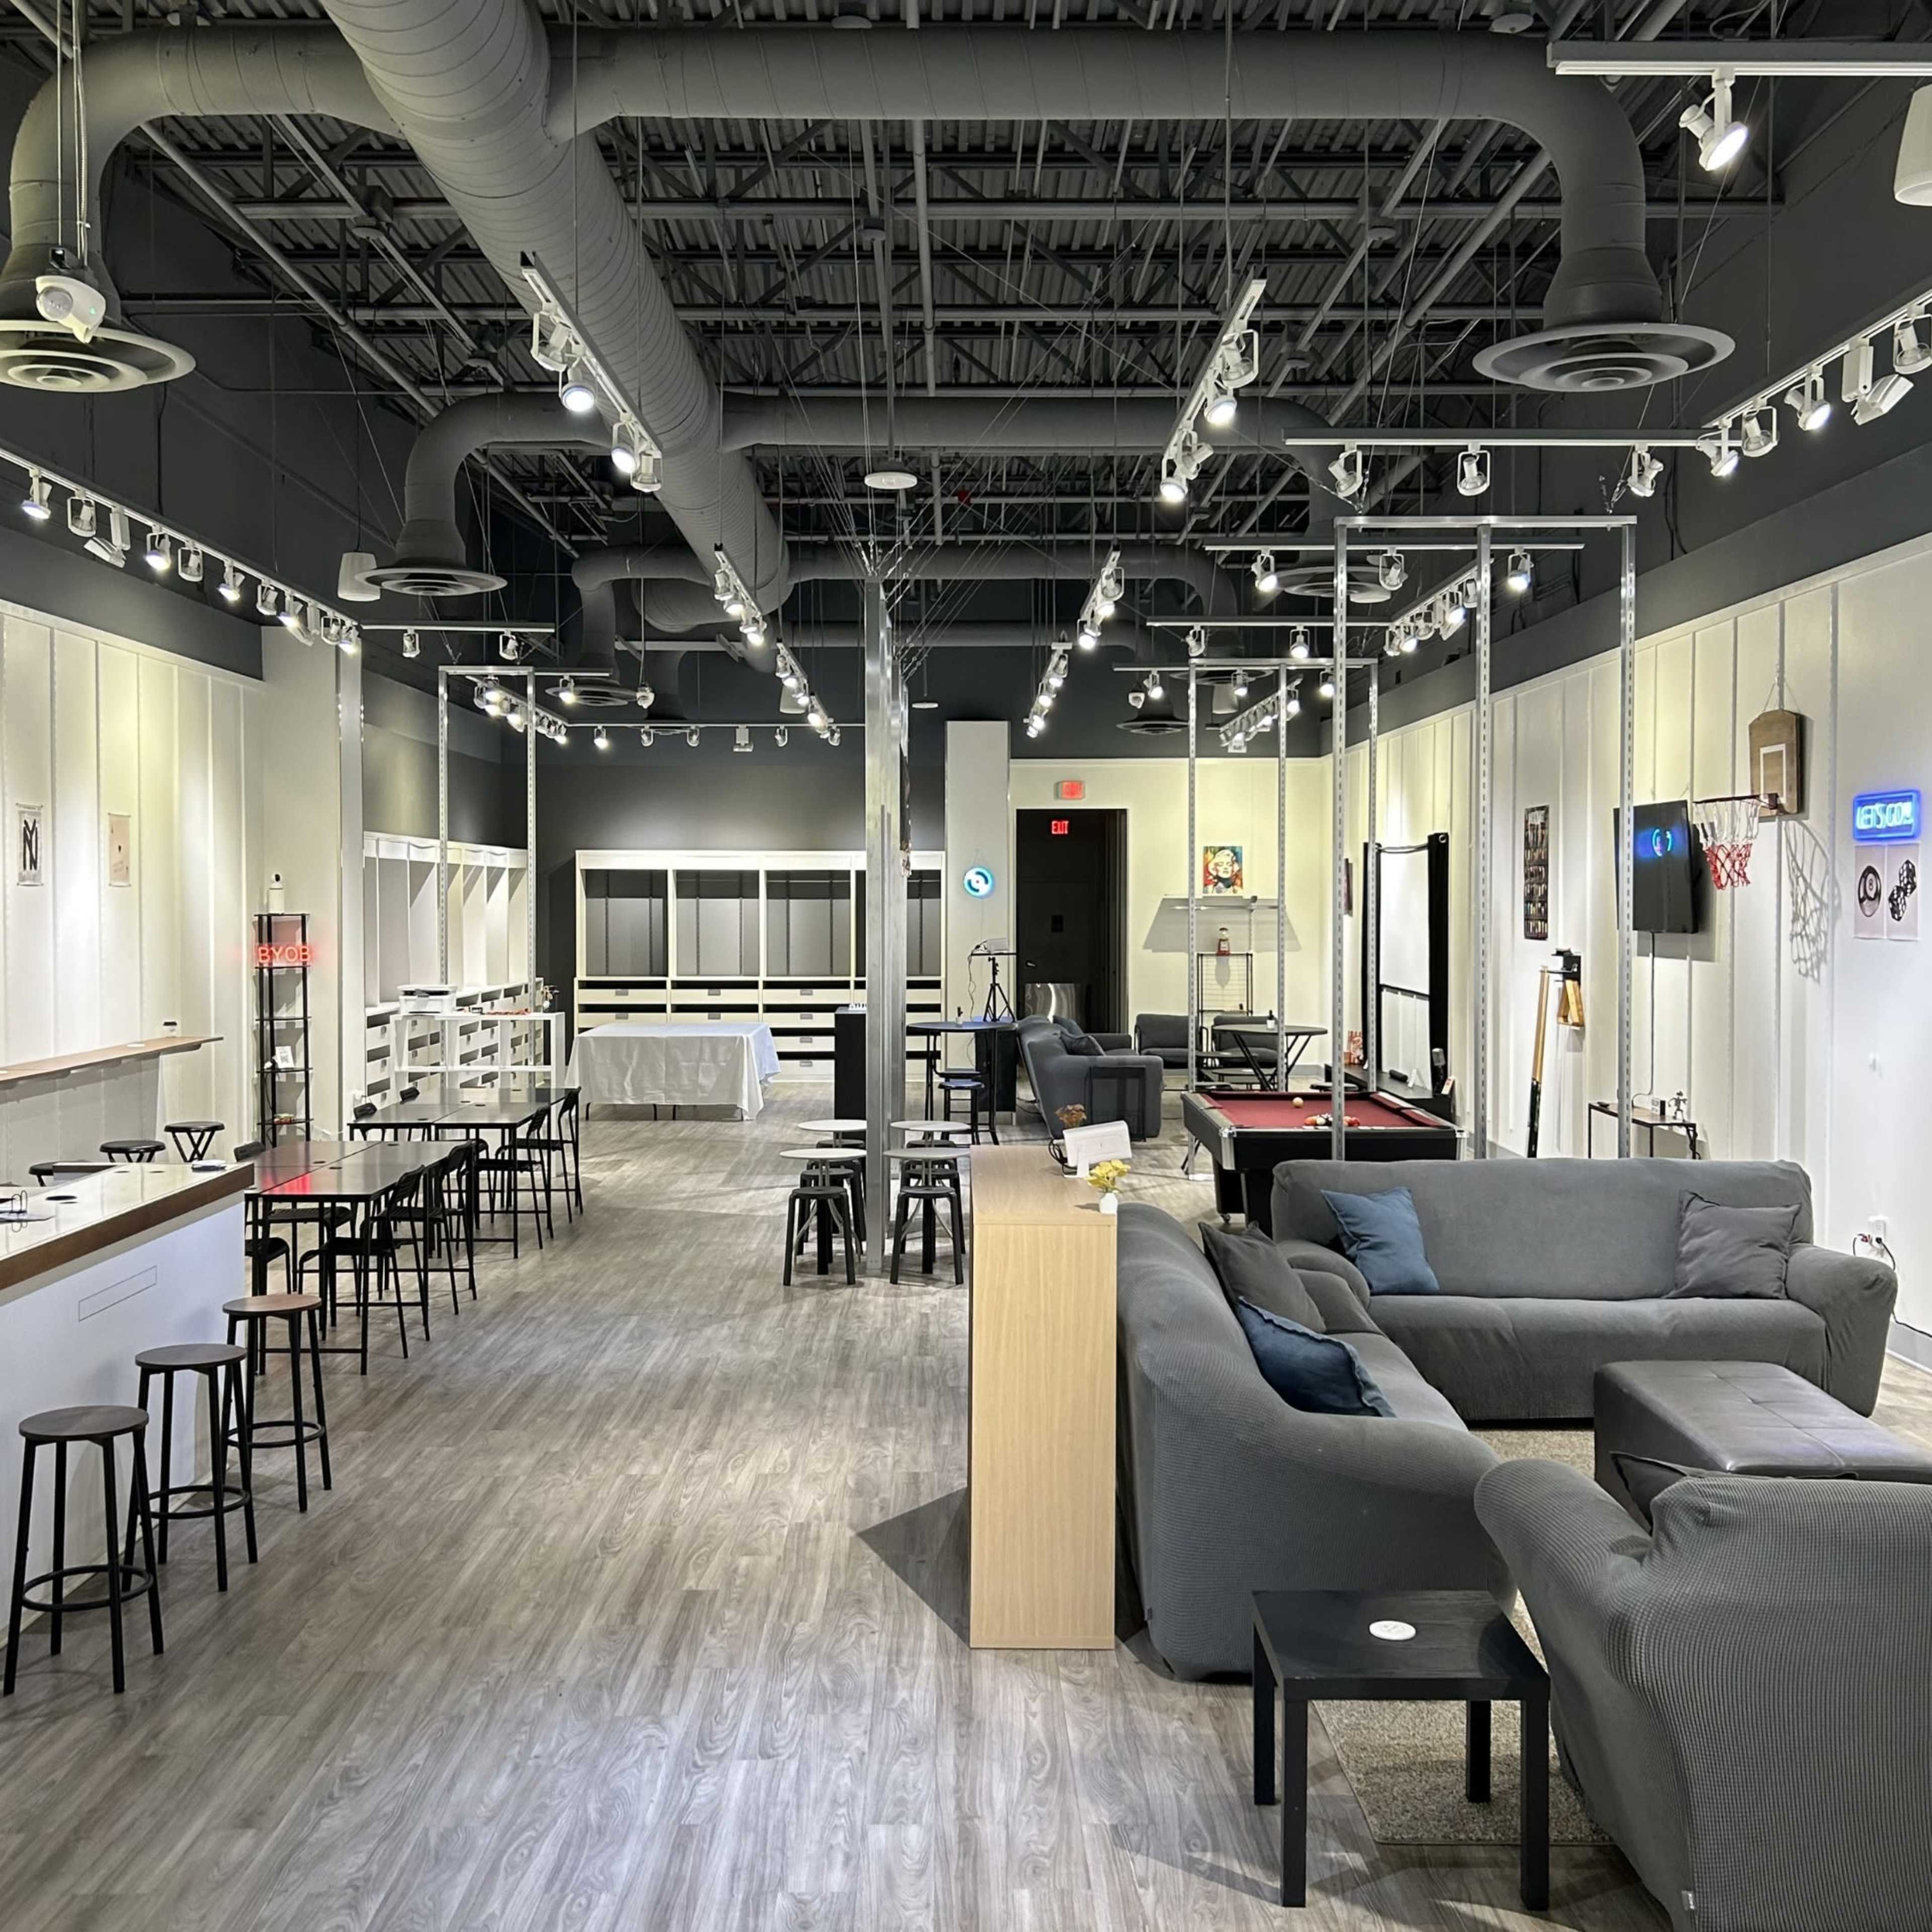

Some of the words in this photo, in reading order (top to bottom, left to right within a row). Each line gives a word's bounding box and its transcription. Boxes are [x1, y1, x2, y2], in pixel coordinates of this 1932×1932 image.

[1052, 821, 1069, 834] EXIT
[1868, 878, 1874, 891] 8
[258, 946, 310, 963] BYOB
